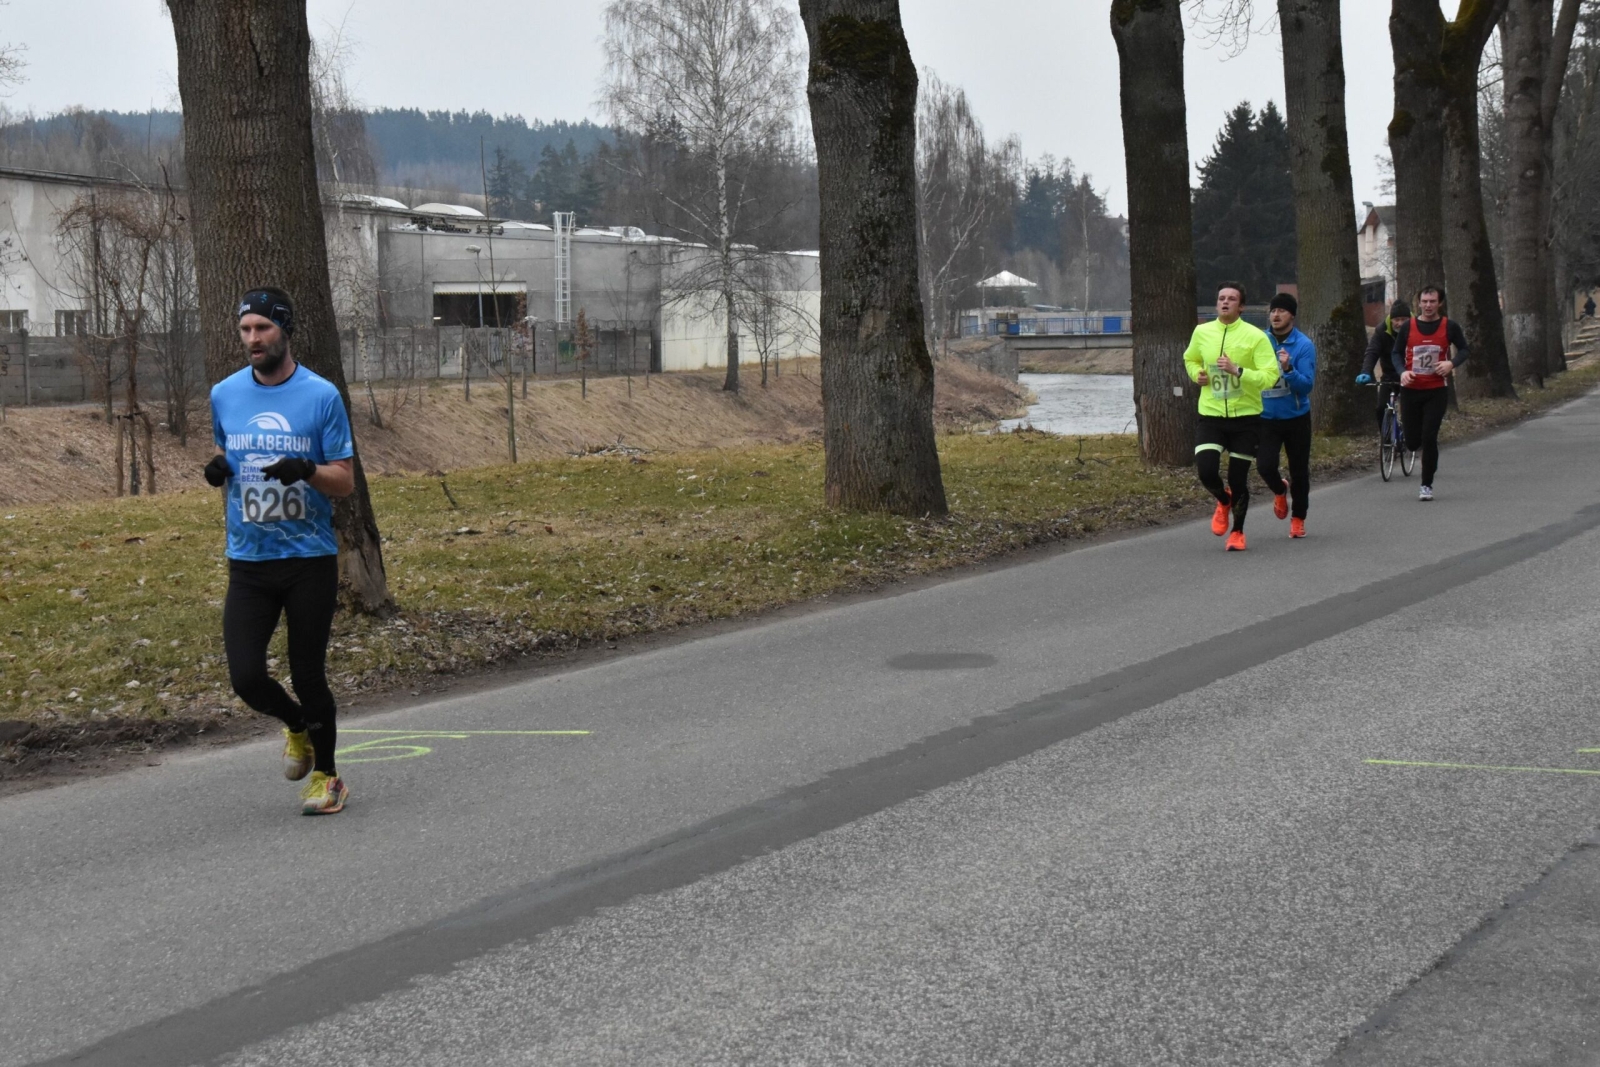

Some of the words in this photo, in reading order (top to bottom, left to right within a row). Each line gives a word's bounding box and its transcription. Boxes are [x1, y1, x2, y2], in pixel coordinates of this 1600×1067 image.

[1419, 354, 1433, 368] 12
[1211, 375, 1240, 391] 670
[228, 434, 311, 452] RUNLABERUN
[244, 486, 303, 522] 626
